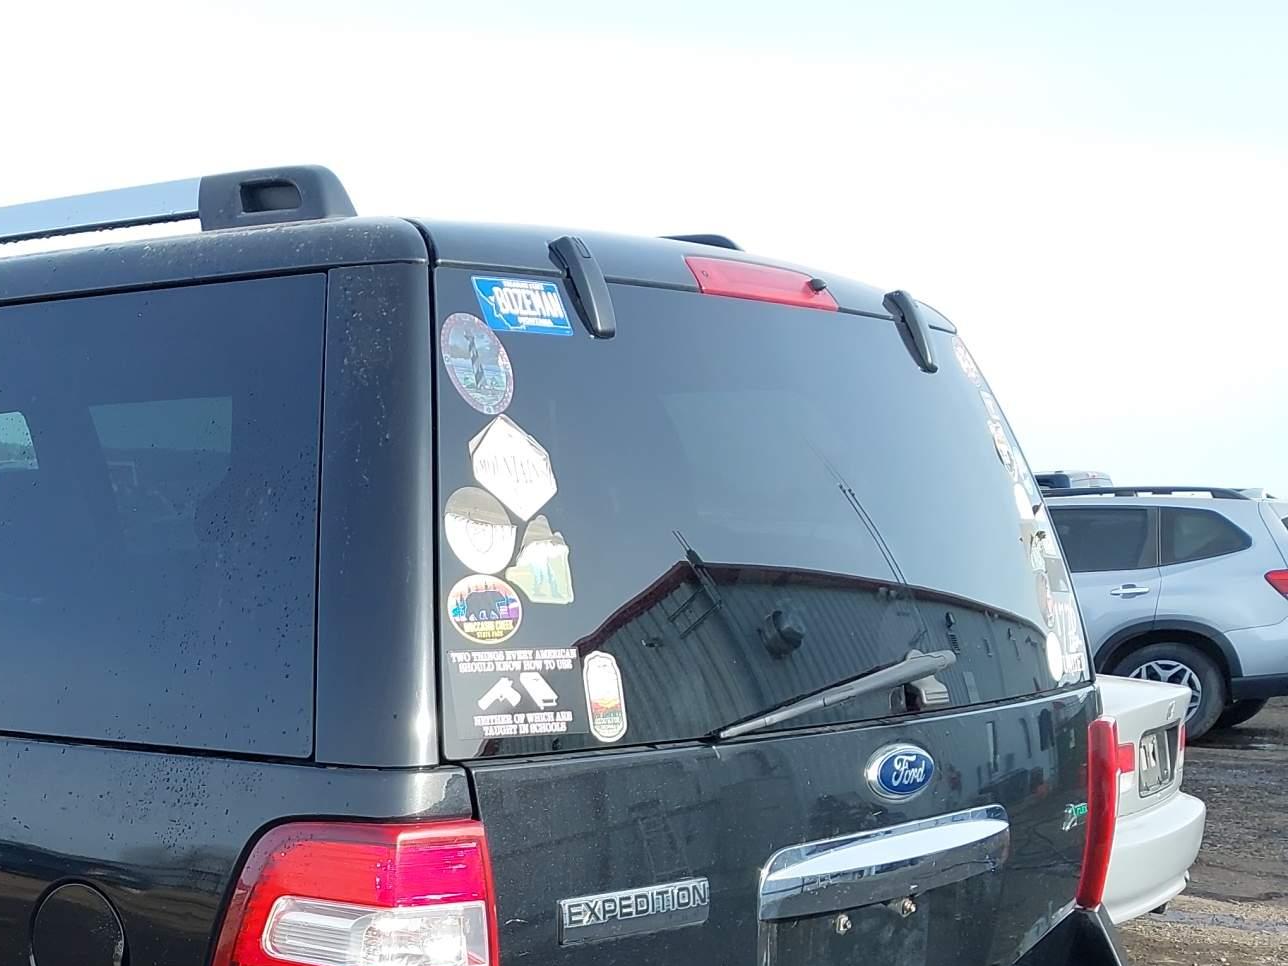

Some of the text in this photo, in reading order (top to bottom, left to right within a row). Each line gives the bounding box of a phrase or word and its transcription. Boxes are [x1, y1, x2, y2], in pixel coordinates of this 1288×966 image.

[492, 287, 564, 318] BOZEMAN
[451, 649, 577, 662] TWO THINGS EVERY AMERICAN
[459, 659, 573, 673] SHOULD KNOW HOW TO USE
[473, 711, 572, 726] NEITHER OF WHICH ARE
[483, 722, 567, 736] TAUGHT IN SCHOOLS
[892, 755, 926, 786] Ford
[565, 882, 709, 928] EXPEDITION
